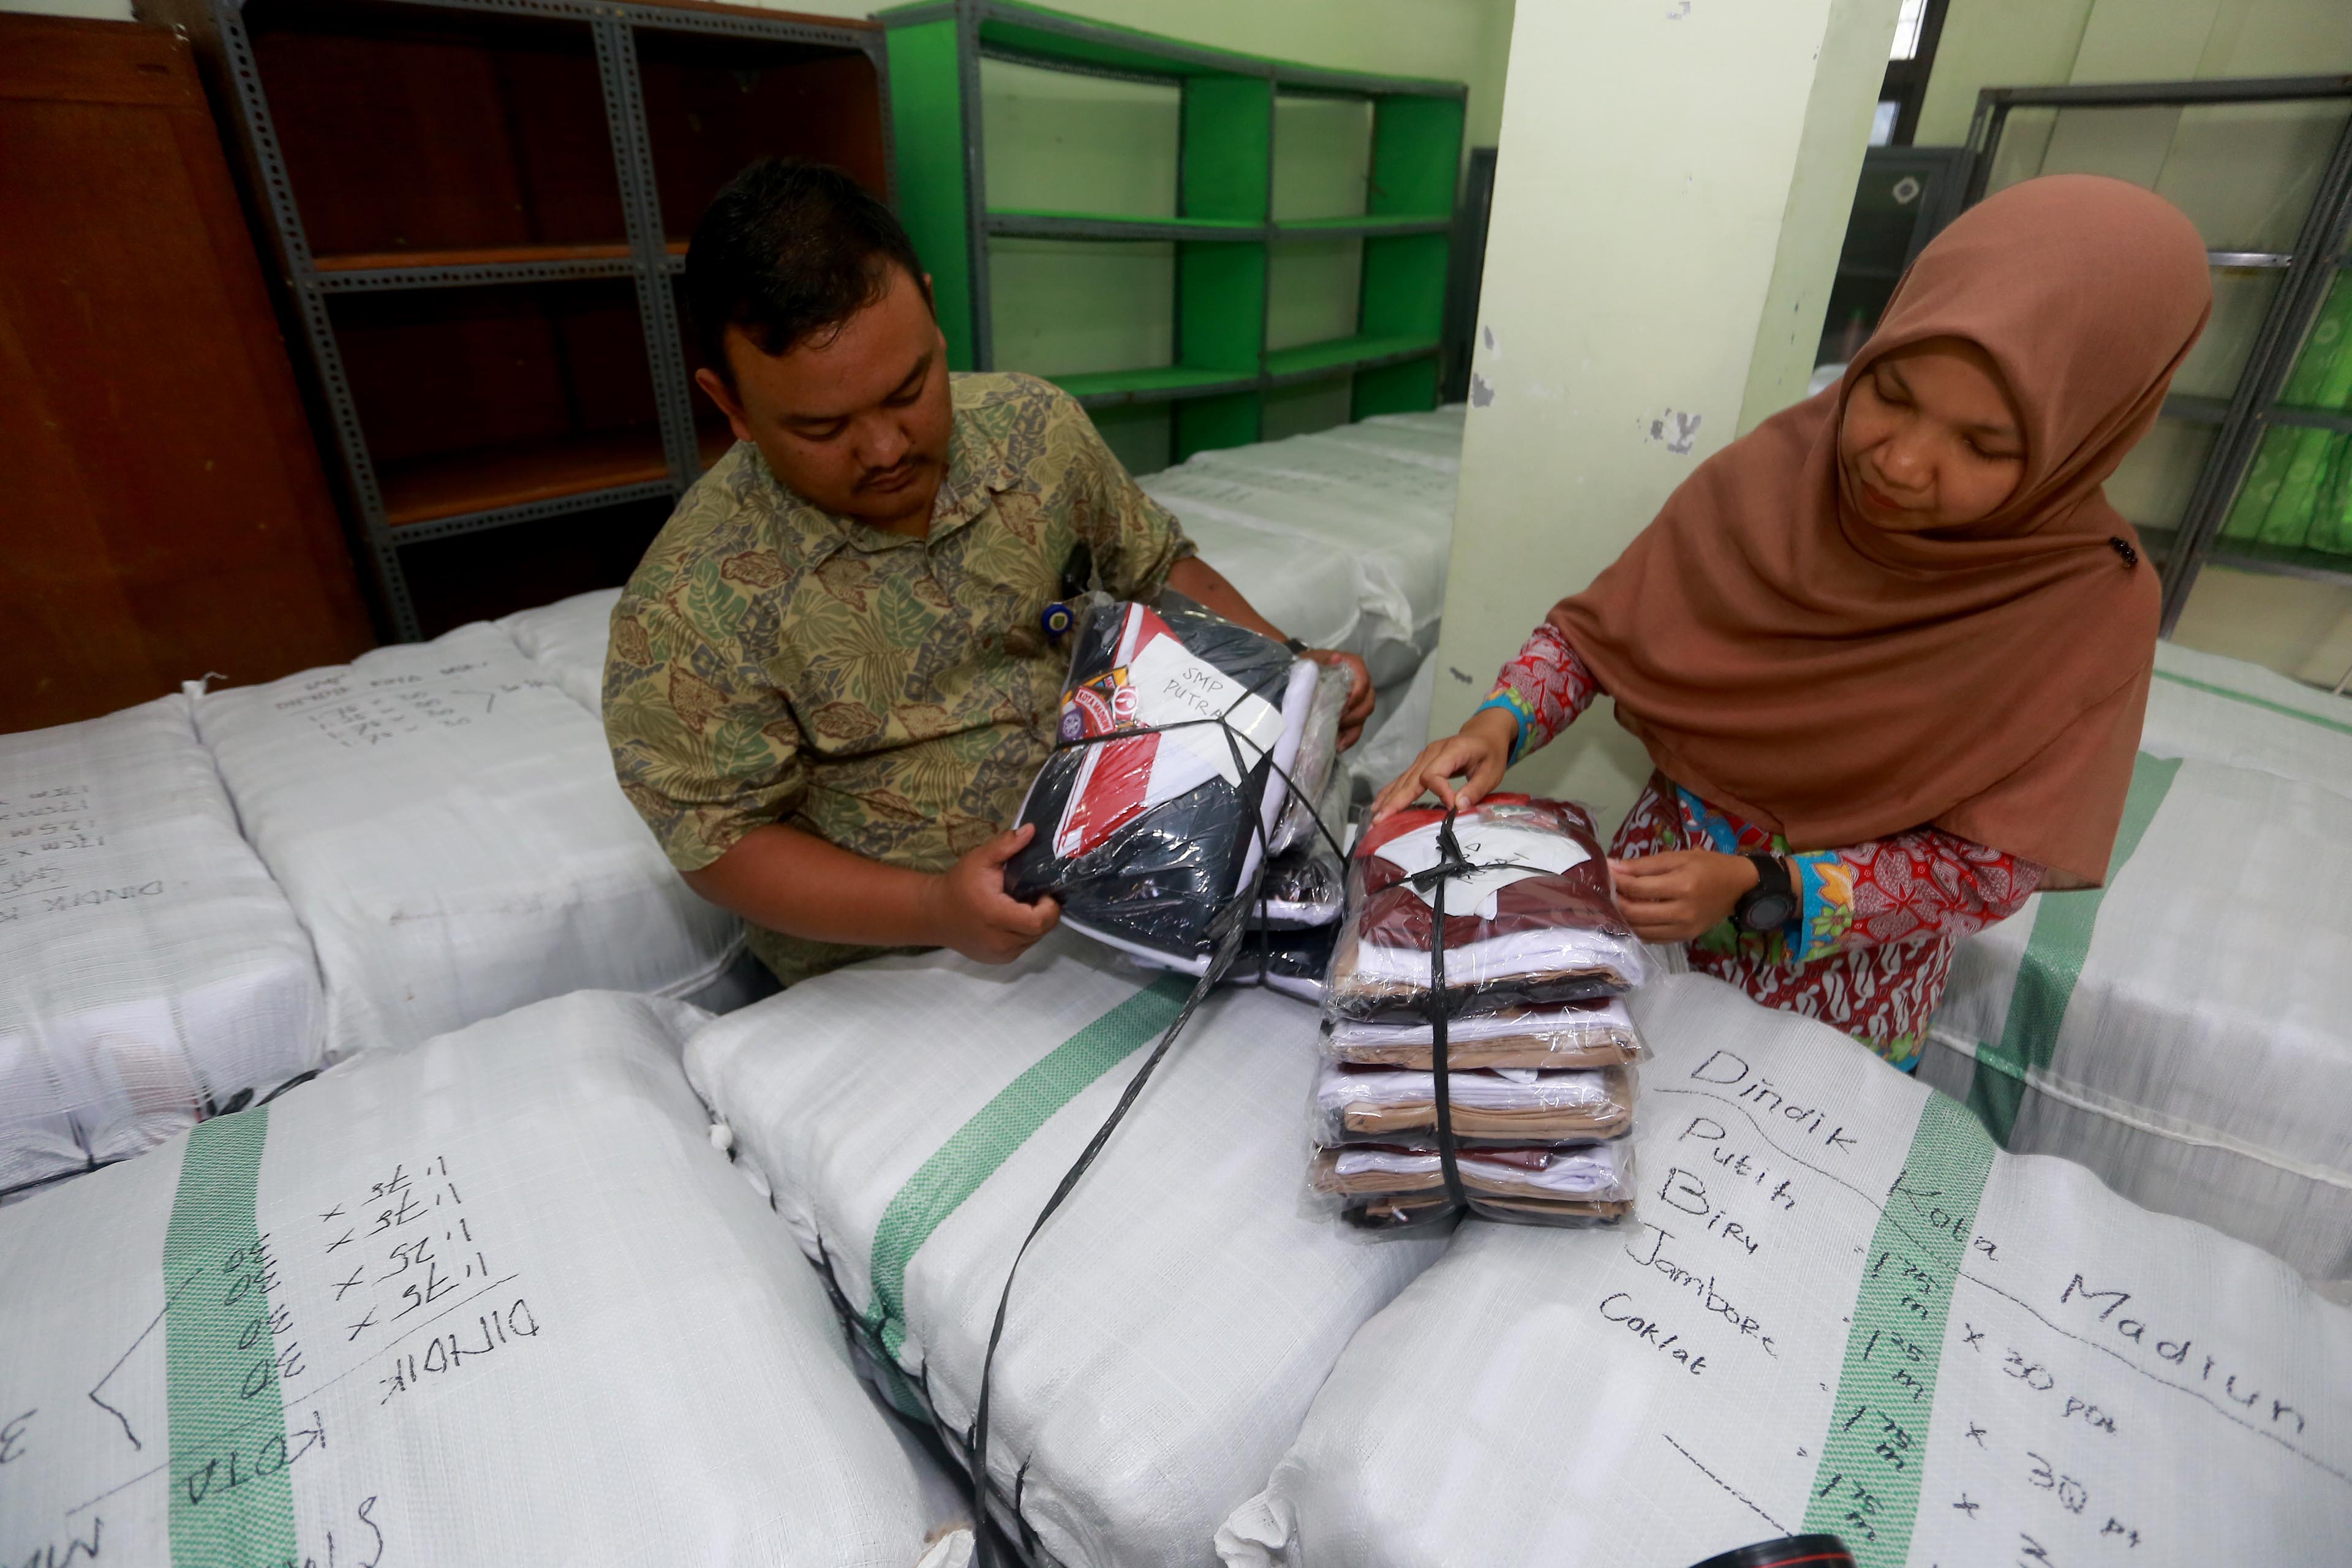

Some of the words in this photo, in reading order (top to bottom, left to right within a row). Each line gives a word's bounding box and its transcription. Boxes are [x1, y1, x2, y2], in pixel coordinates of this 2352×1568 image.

[1163, 679, 1223, 719] PUTRA
[1182, 666, 1224, 693] SMP
[41, 880, 164, 912] DINDIK
[1678, 1117, 1795, 1212] Putih
[1691, 1049, 1857, 1155] Dindik
[1885, 1169, 1999, 1262] Kota
[2060, 1273, 2305, 1434] Madiun
[379, 1298, 540, 1406] DINDIK
[1599, 1292, 1707, 1377] Coklat
[188, 1411, 326, 1505] KOTA
